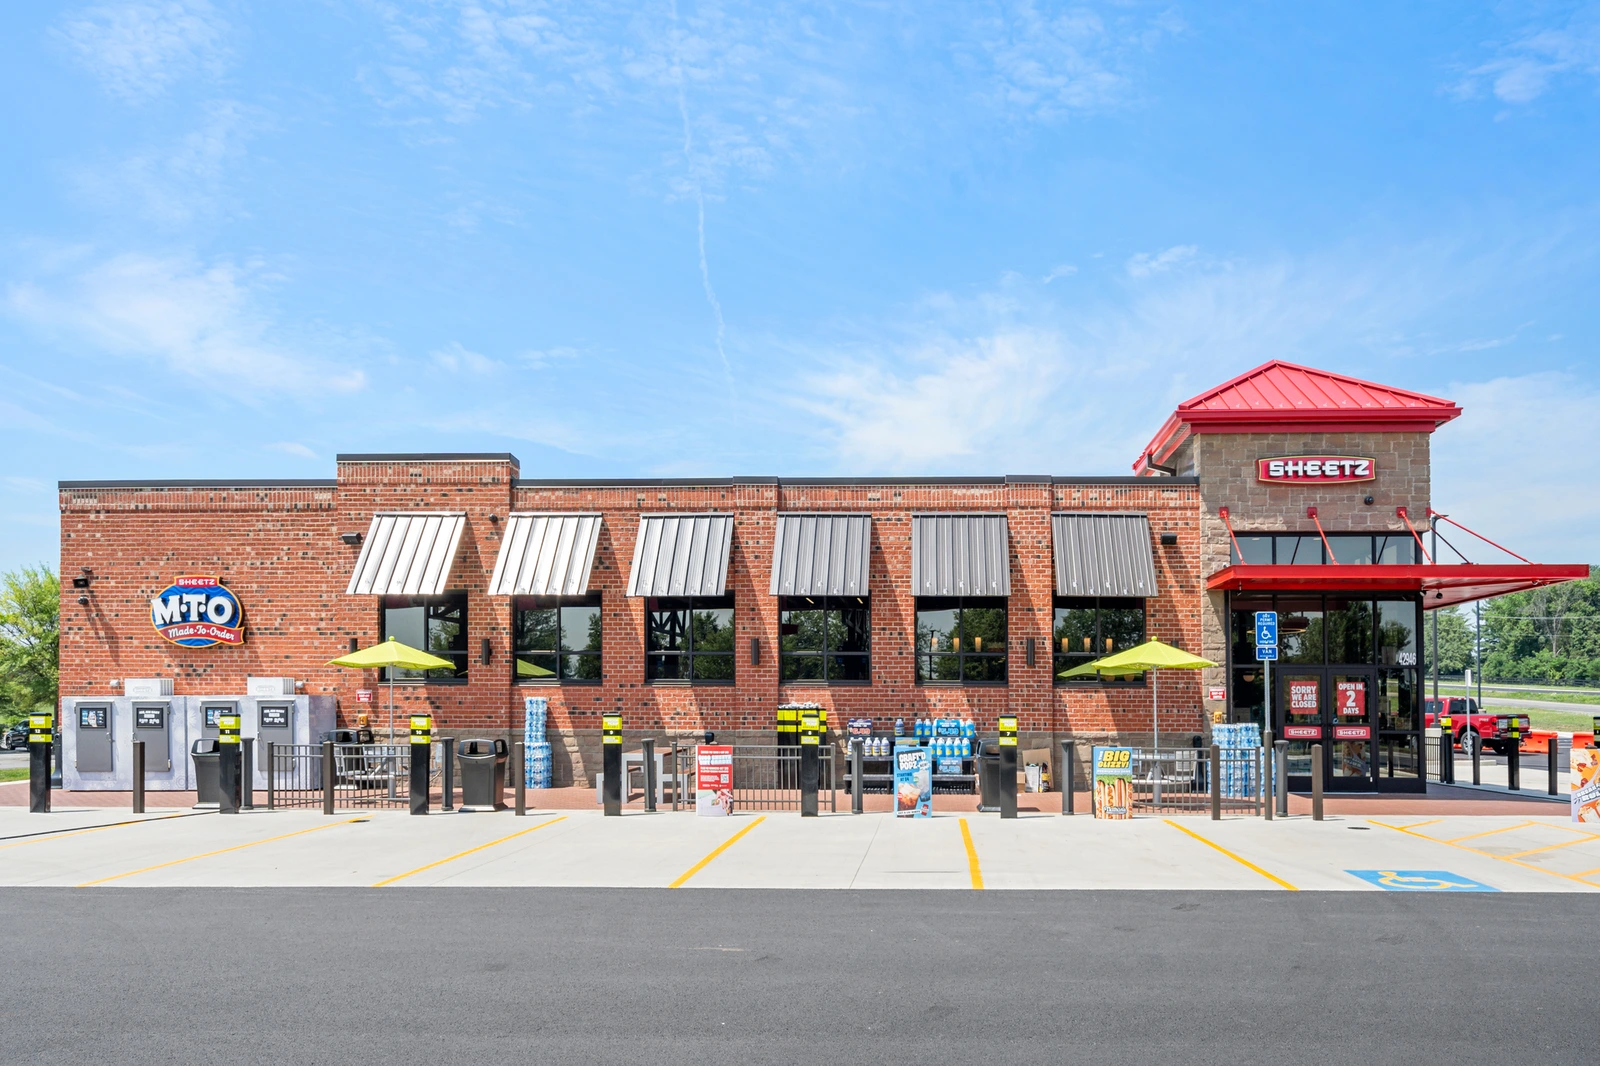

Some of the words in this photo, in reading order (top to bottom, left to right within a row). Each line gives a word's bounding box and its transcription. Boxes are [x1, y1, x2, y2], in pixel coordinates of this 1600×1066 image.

[1269, 460, 1369, 477] SHEETZ
[178, 578, 215, 586] SHEETZ
[1291, 685, 1316, 694] SORRY
[1346, 690, 1356, 707] 2
[1103, 750, 1130, 761] BIG
[899, 761, 917, 771] POPZ
